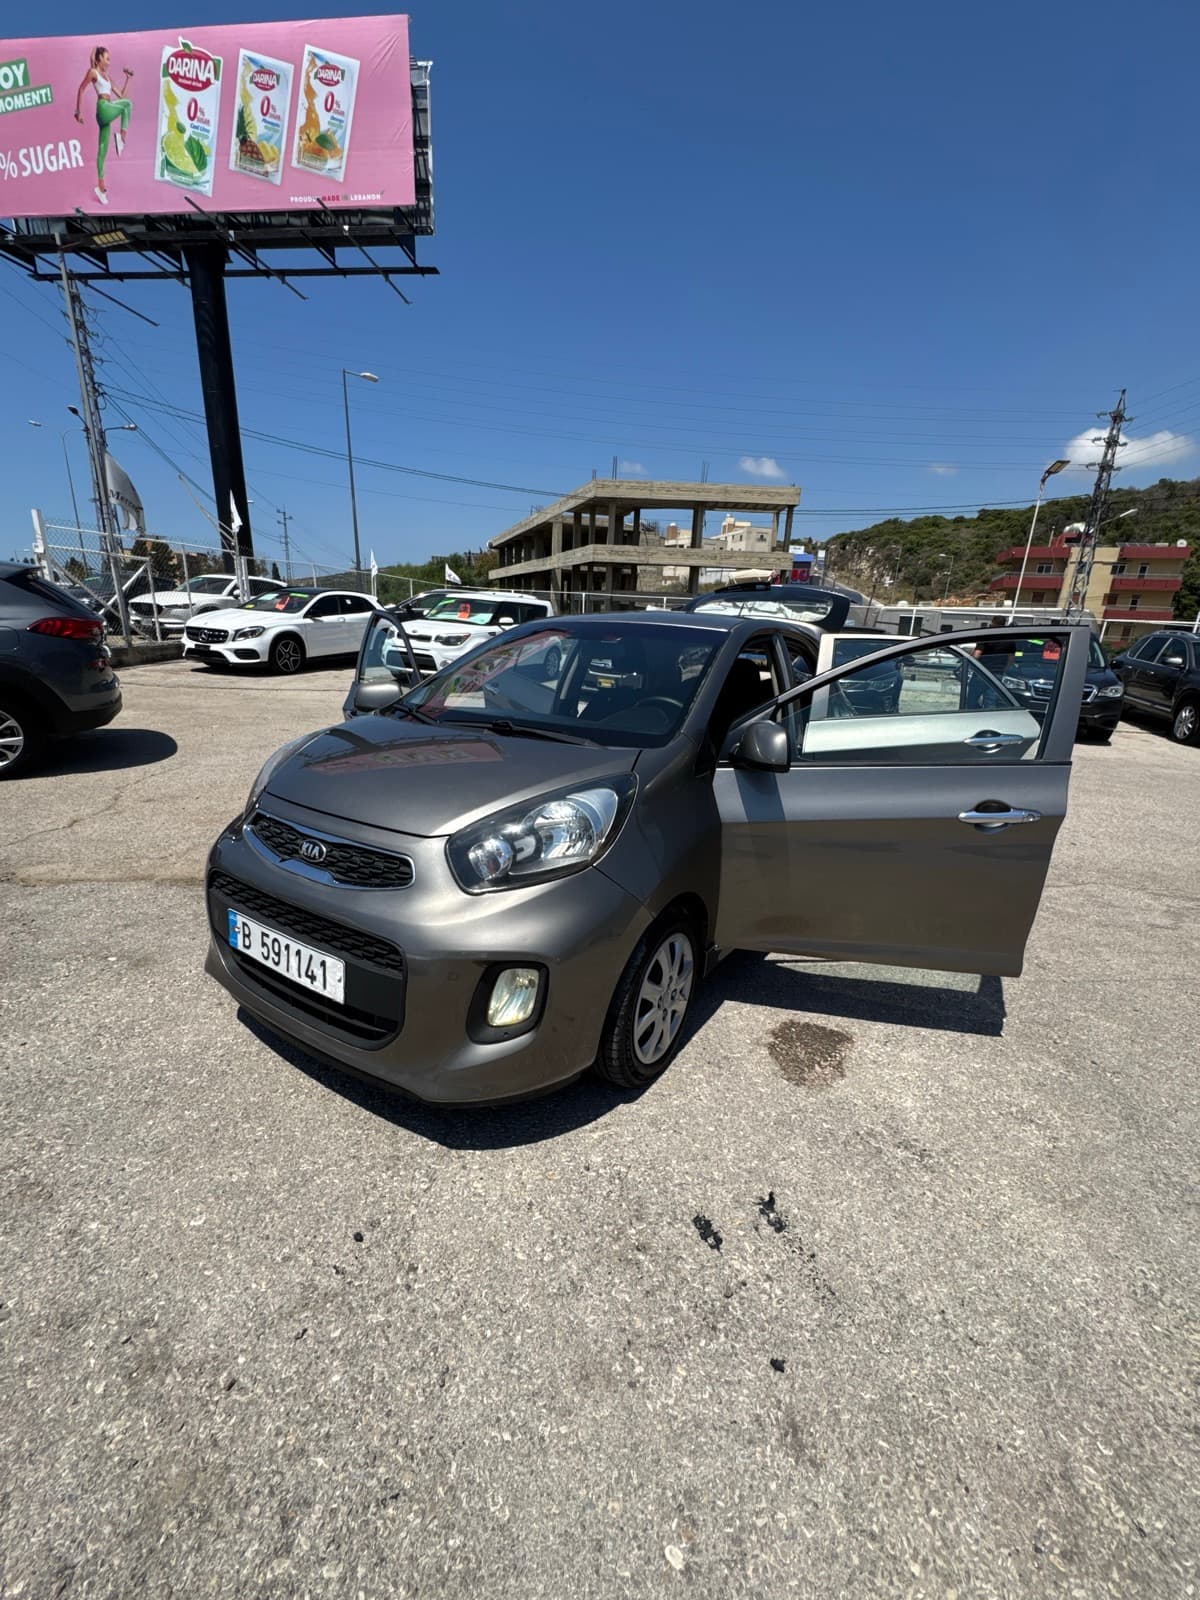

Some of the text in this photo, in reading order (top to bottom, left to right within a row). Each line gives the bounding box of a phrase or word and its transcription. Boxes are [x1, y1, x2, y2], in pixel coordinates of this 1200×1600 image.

[168, 57, 215, 84] DARINA
[317, 68, 342, 82] DARINA
[252, 72, 277, 87] DARINA
[19, 139, 84, 177] SUGAR
[350, 193, 381, 201] LEBANON
[301, 841, 320, 858] KIA
[242, 921, 327, 991] B 591141
